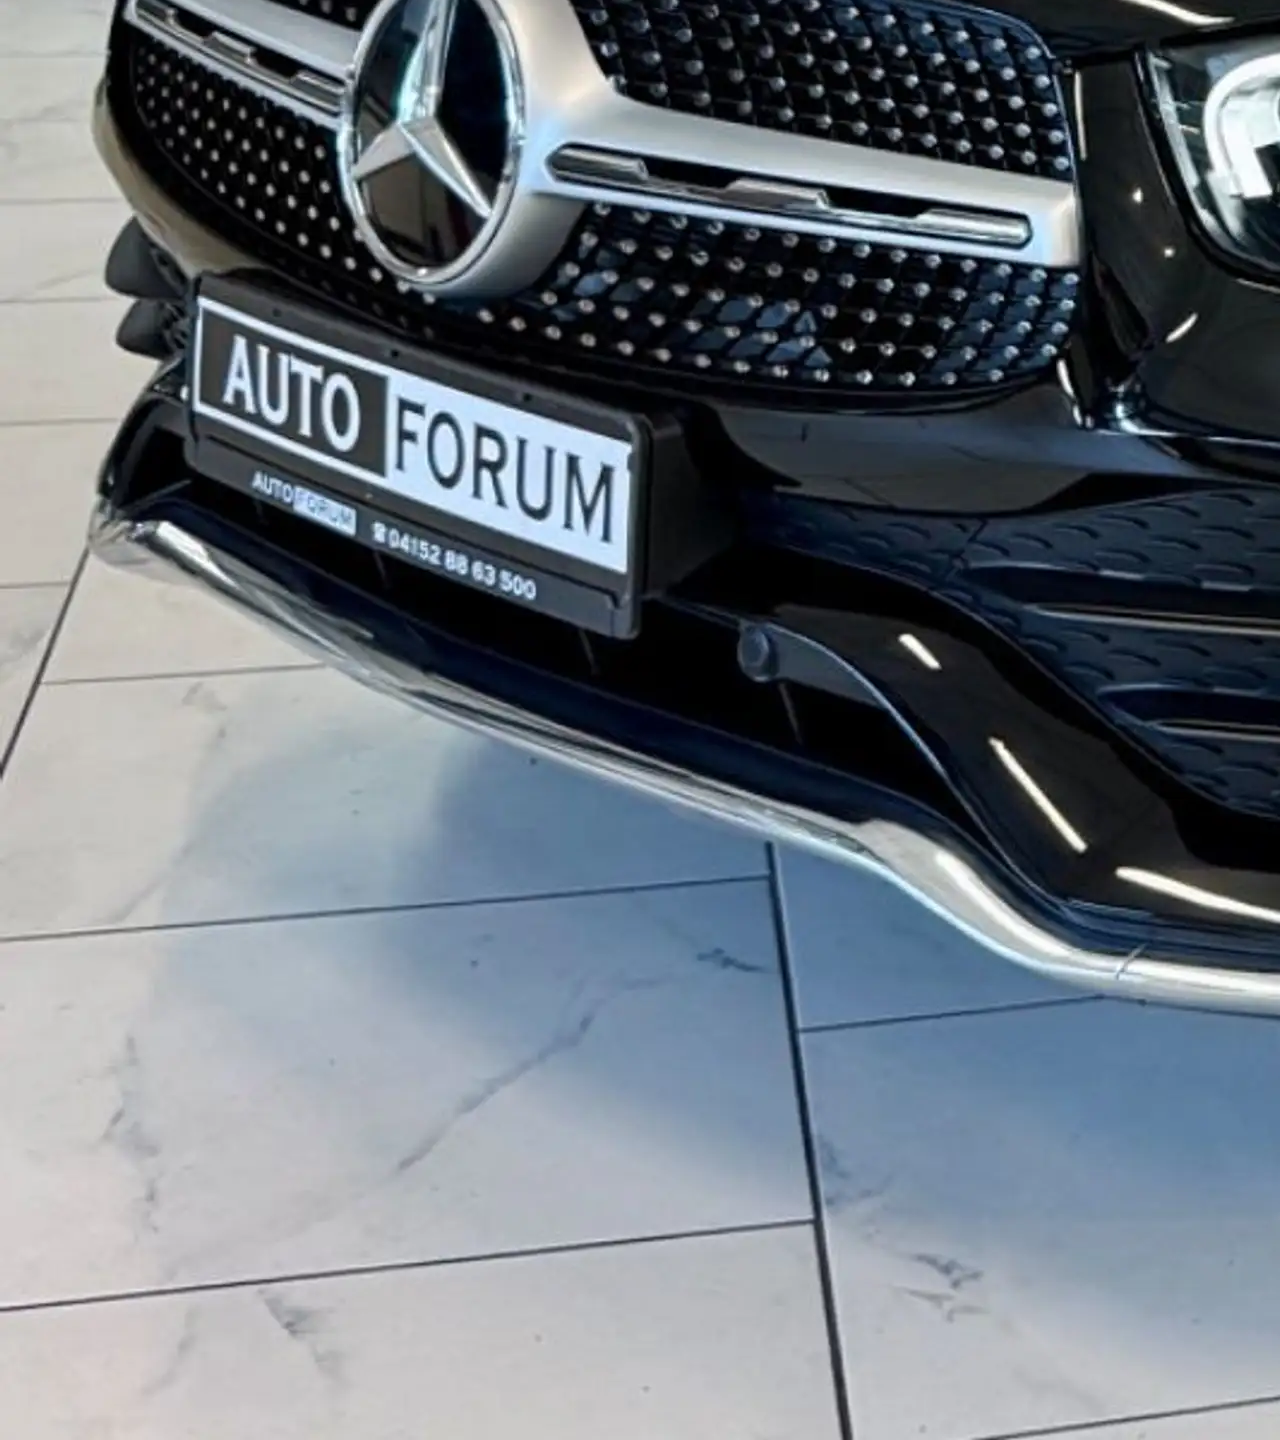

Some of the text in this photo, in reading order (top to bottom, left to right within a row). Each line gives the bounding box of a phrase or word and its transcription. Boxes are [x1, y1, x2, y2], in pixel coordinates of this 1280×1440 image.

[222, 334, 616, 544] AUTO FORUM
[388, 525, 442, 566] 04152
[499, 570, 537, 601] 500
